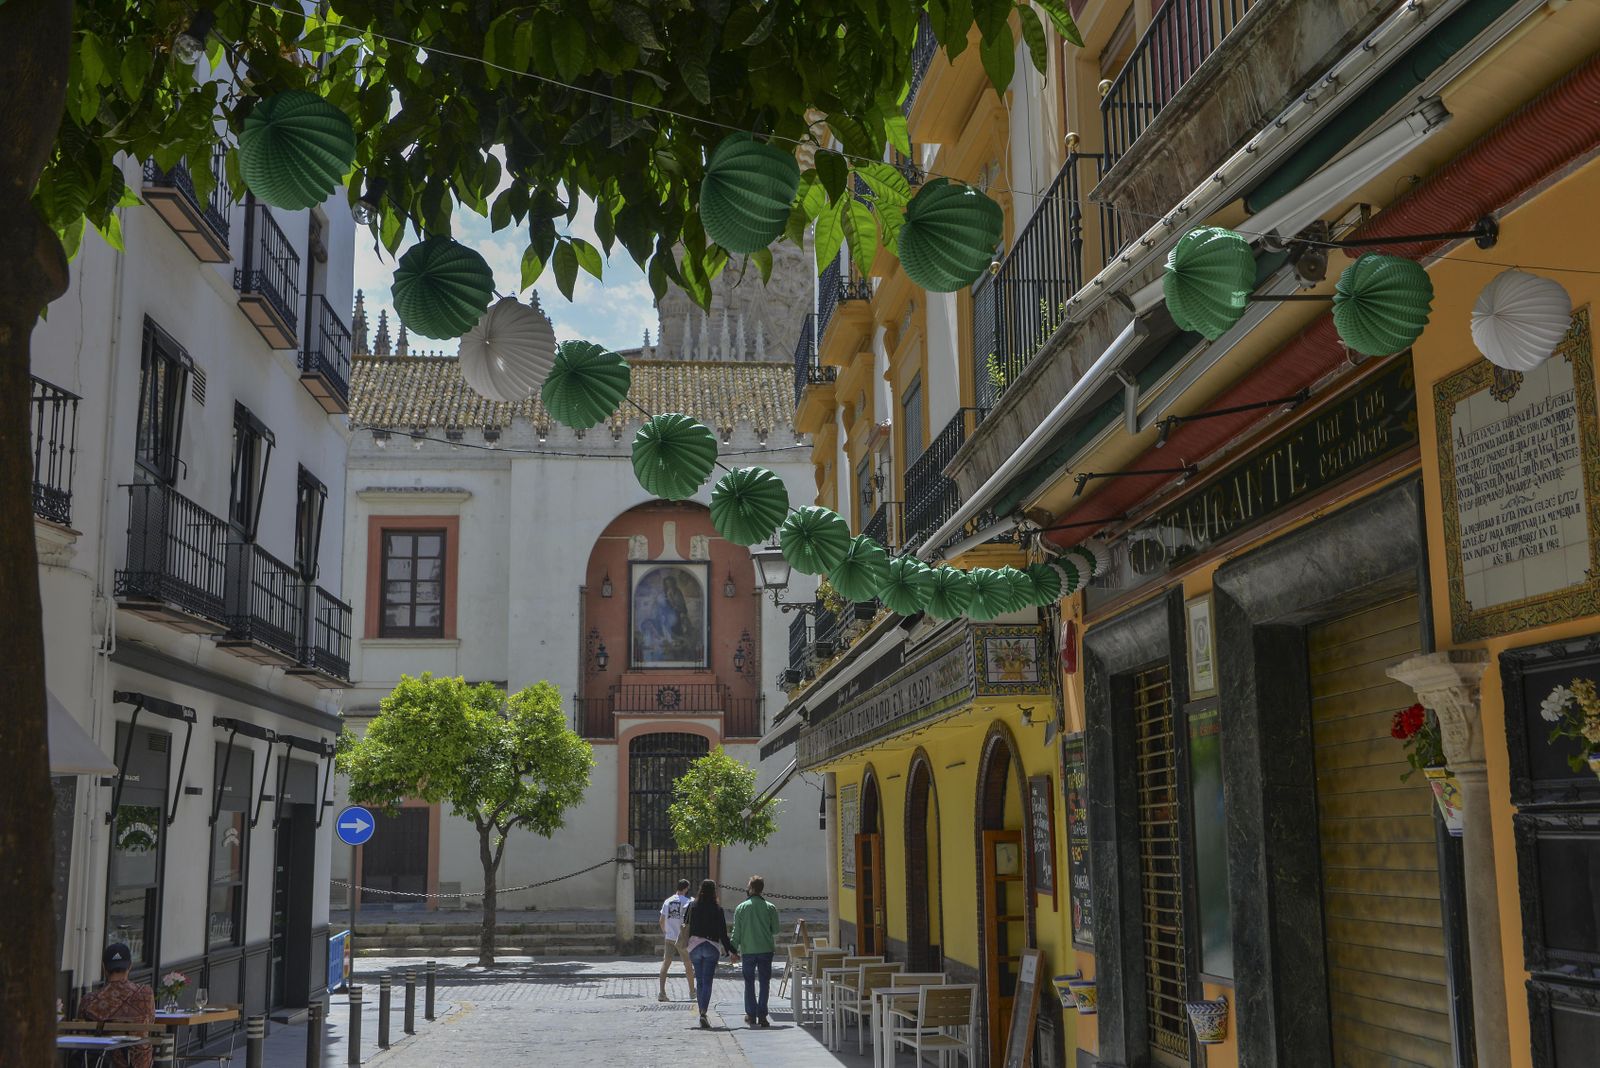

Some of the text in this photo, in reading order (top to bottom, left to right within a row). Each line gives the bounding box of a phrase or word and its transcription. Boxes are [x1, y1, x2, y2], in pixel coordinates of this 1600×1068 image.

[1129, 437, 1307, 579] RESTAURANTE
[858, 697, 890, 733] FUNDADO
[893, 688, 904, 716] EN
[908, 676, 931, 710] 1920
